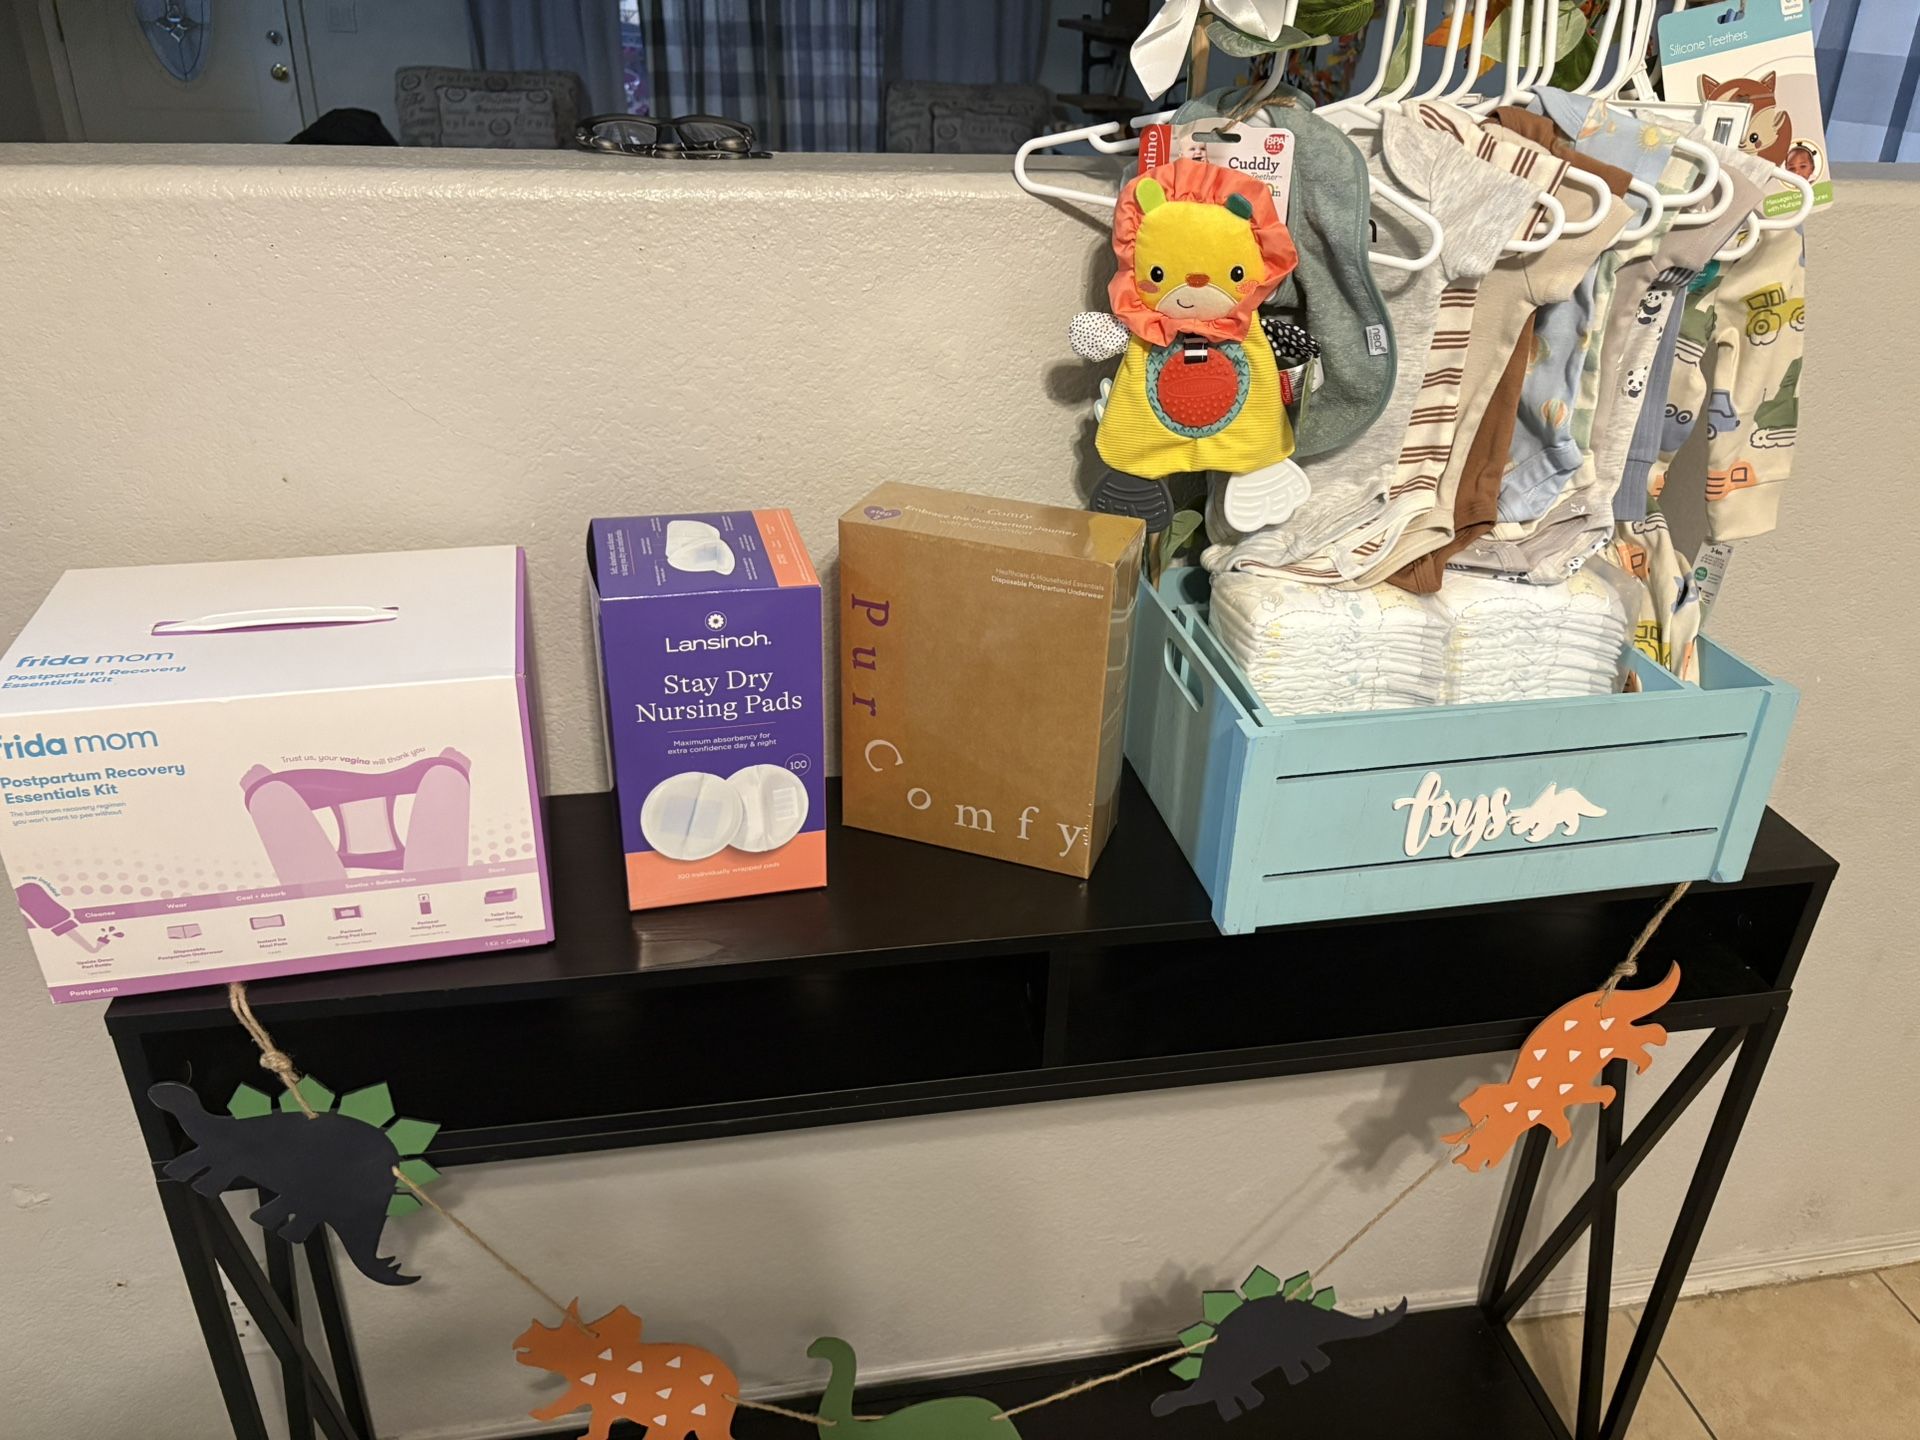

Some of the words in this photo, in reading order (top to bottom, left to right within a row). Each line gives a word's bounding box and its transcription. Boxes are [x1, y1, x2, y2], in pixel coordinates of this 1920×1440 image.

[1669, 39, 1706, 57] Silicone
[1707, 29, 1748, 46] Teethers
[1228, 156, 1280, 174] Cuddly
[991, 575, 1027, 588] Disposable
[1028, 581, 1066, 595] Postpartum
[1067, 587, 1105, 599] Underwear
[16, 654, 90, 668] frida
[95, 652, 175, 664] mom
[1, 677, 86, 689] Essentials
[90, 676, 113, 684] Kit
[7, 669, 105, 682] Postpartum
[109, 665, 187, 676] Recovery
[664, 674, 719, 697] Stay
[726, 669, 773, 692] Dry
[635, 699, 738, 723] Nursing
[745, 691, 802, 714] Pads
[0, 733, 68, 759] rida
[74, 729, 159, 753] mom
[667, 747, 688, 755] extra
[689, 743, 732, 754] confidence
[733, 743, 748, 751] day
[757, 739, 777, 748] night
[673, 738, 711, 747] Maximum
[713, 733, 757, 744] absorbency
[281, 754, 302, 763] Trust
[318, 755, 339, 763] your
[340, 756, 371, 766] vagina
[388, 751, 409, 765] thank
[410, 747, 426, 758] you
[790, 760, 807, 769] 100
[1, 771, 101, 789] Postpartum
[104, 762, 186, 780] Recovery
[4, 786, 91, 804] Essentials
[93, 784, 119, 796] Kit
[1392, 771, 1511, 858] toys
[69, 986, 119, 997] Postpartum
